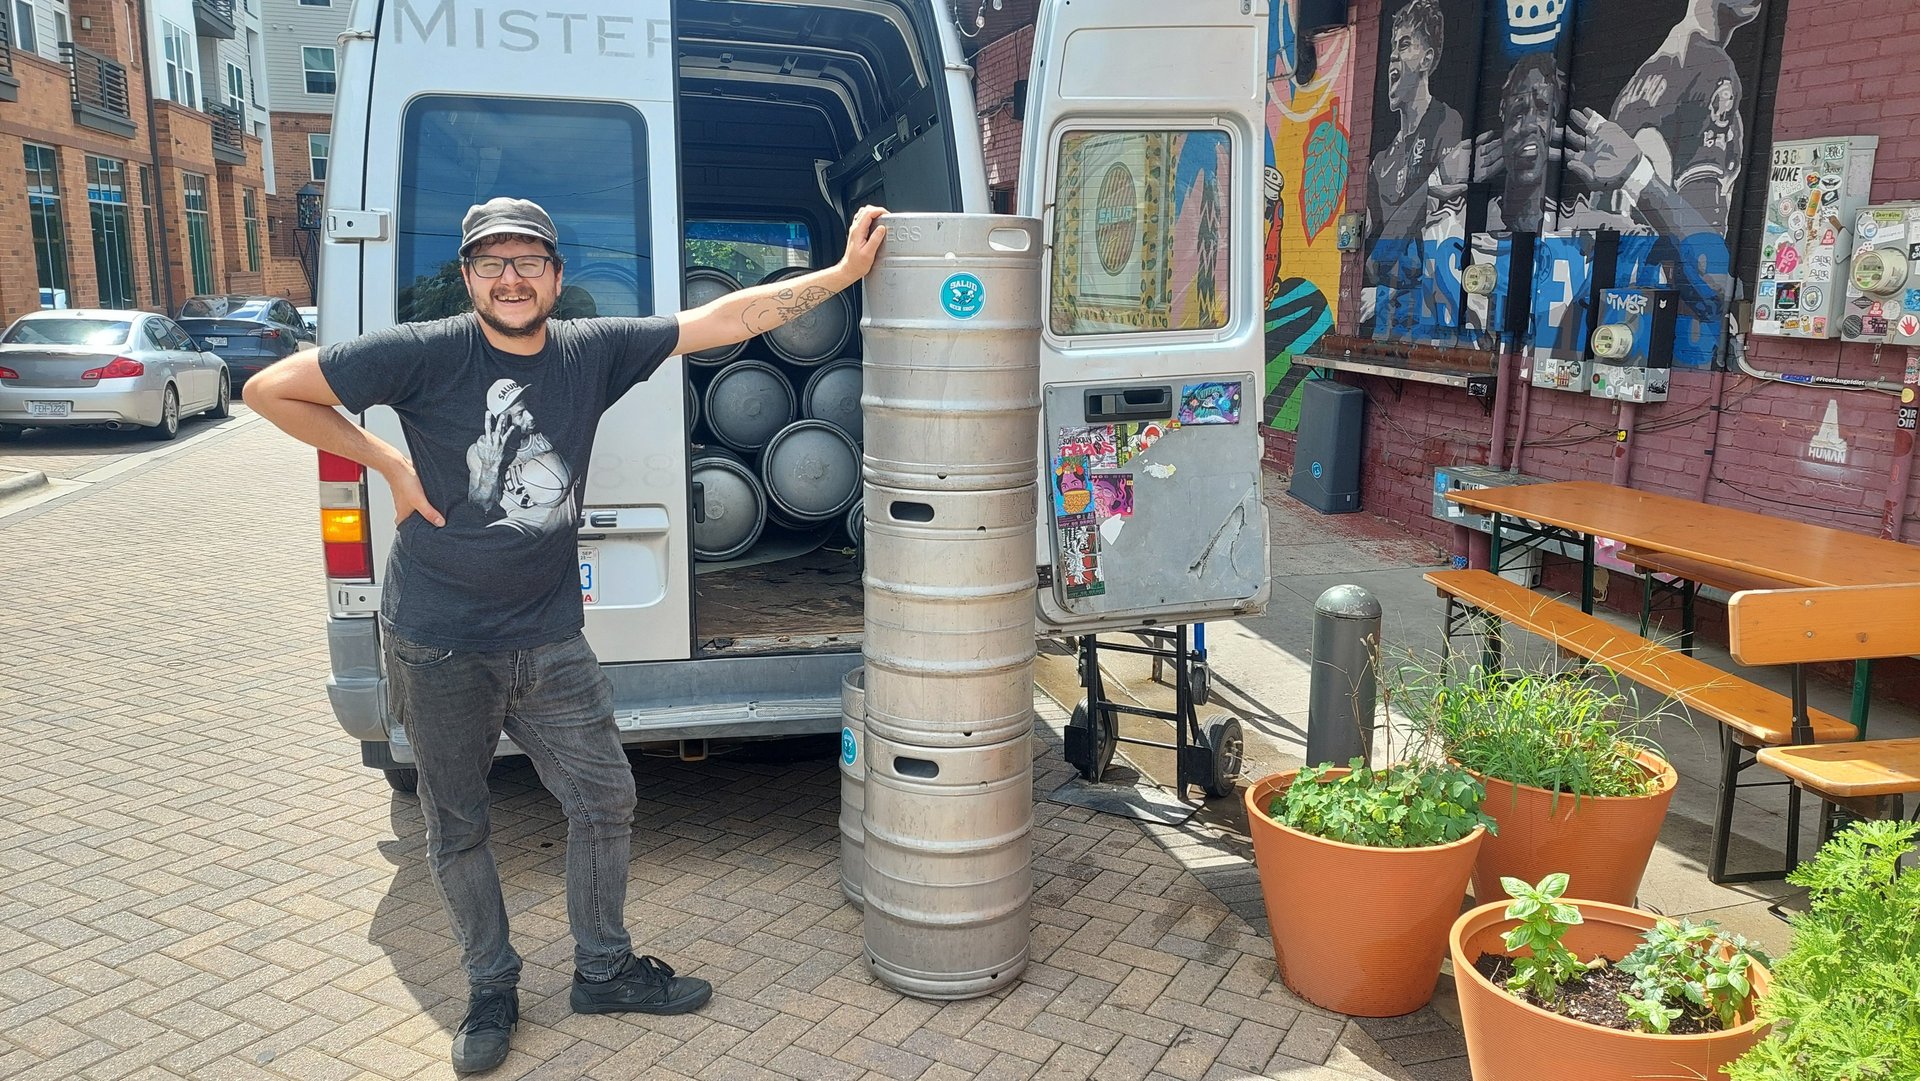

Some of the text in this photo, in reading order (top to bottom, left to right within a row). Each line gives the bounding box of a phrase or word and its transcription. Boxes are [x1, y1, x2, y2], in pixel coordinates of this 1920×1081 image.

[1771, 167, 1801, 182] WOKE
[886, 225, 922, 243] EGS
[949, 280, 978, 291] SALUD
[498, 383, 519, 401] SALUD
[1808, 446, 1847, 464] HUMAN
